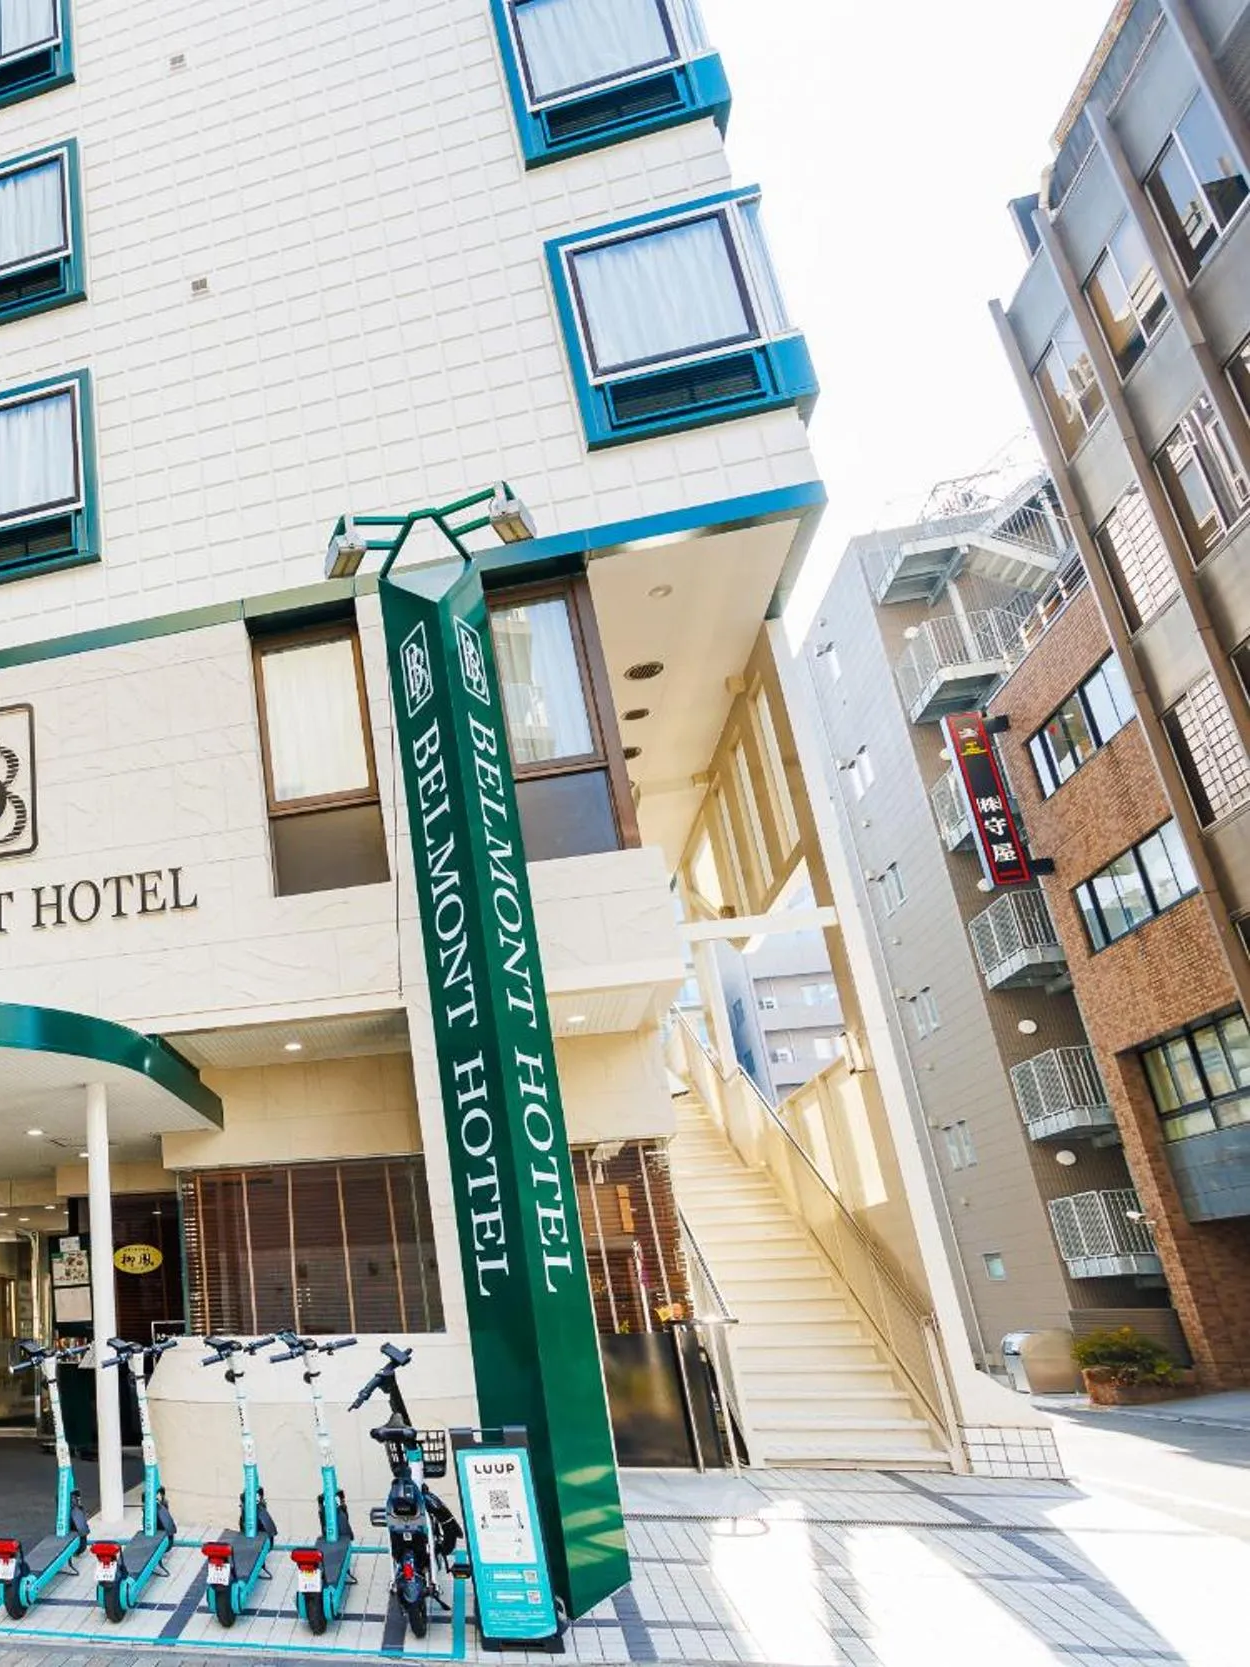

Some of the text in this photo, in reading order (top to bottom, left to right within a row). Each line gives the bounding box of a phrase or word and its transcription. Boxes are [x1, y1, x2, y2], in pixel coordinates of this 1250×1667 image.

[31, 867, 198, 929] HOTEL
[411, 717, 509, 1297] BELMONT HOTEL
[467, 711, 573, 1292] BELMONT HOTEL
[474, 1463, 515, 1474] LUUP
